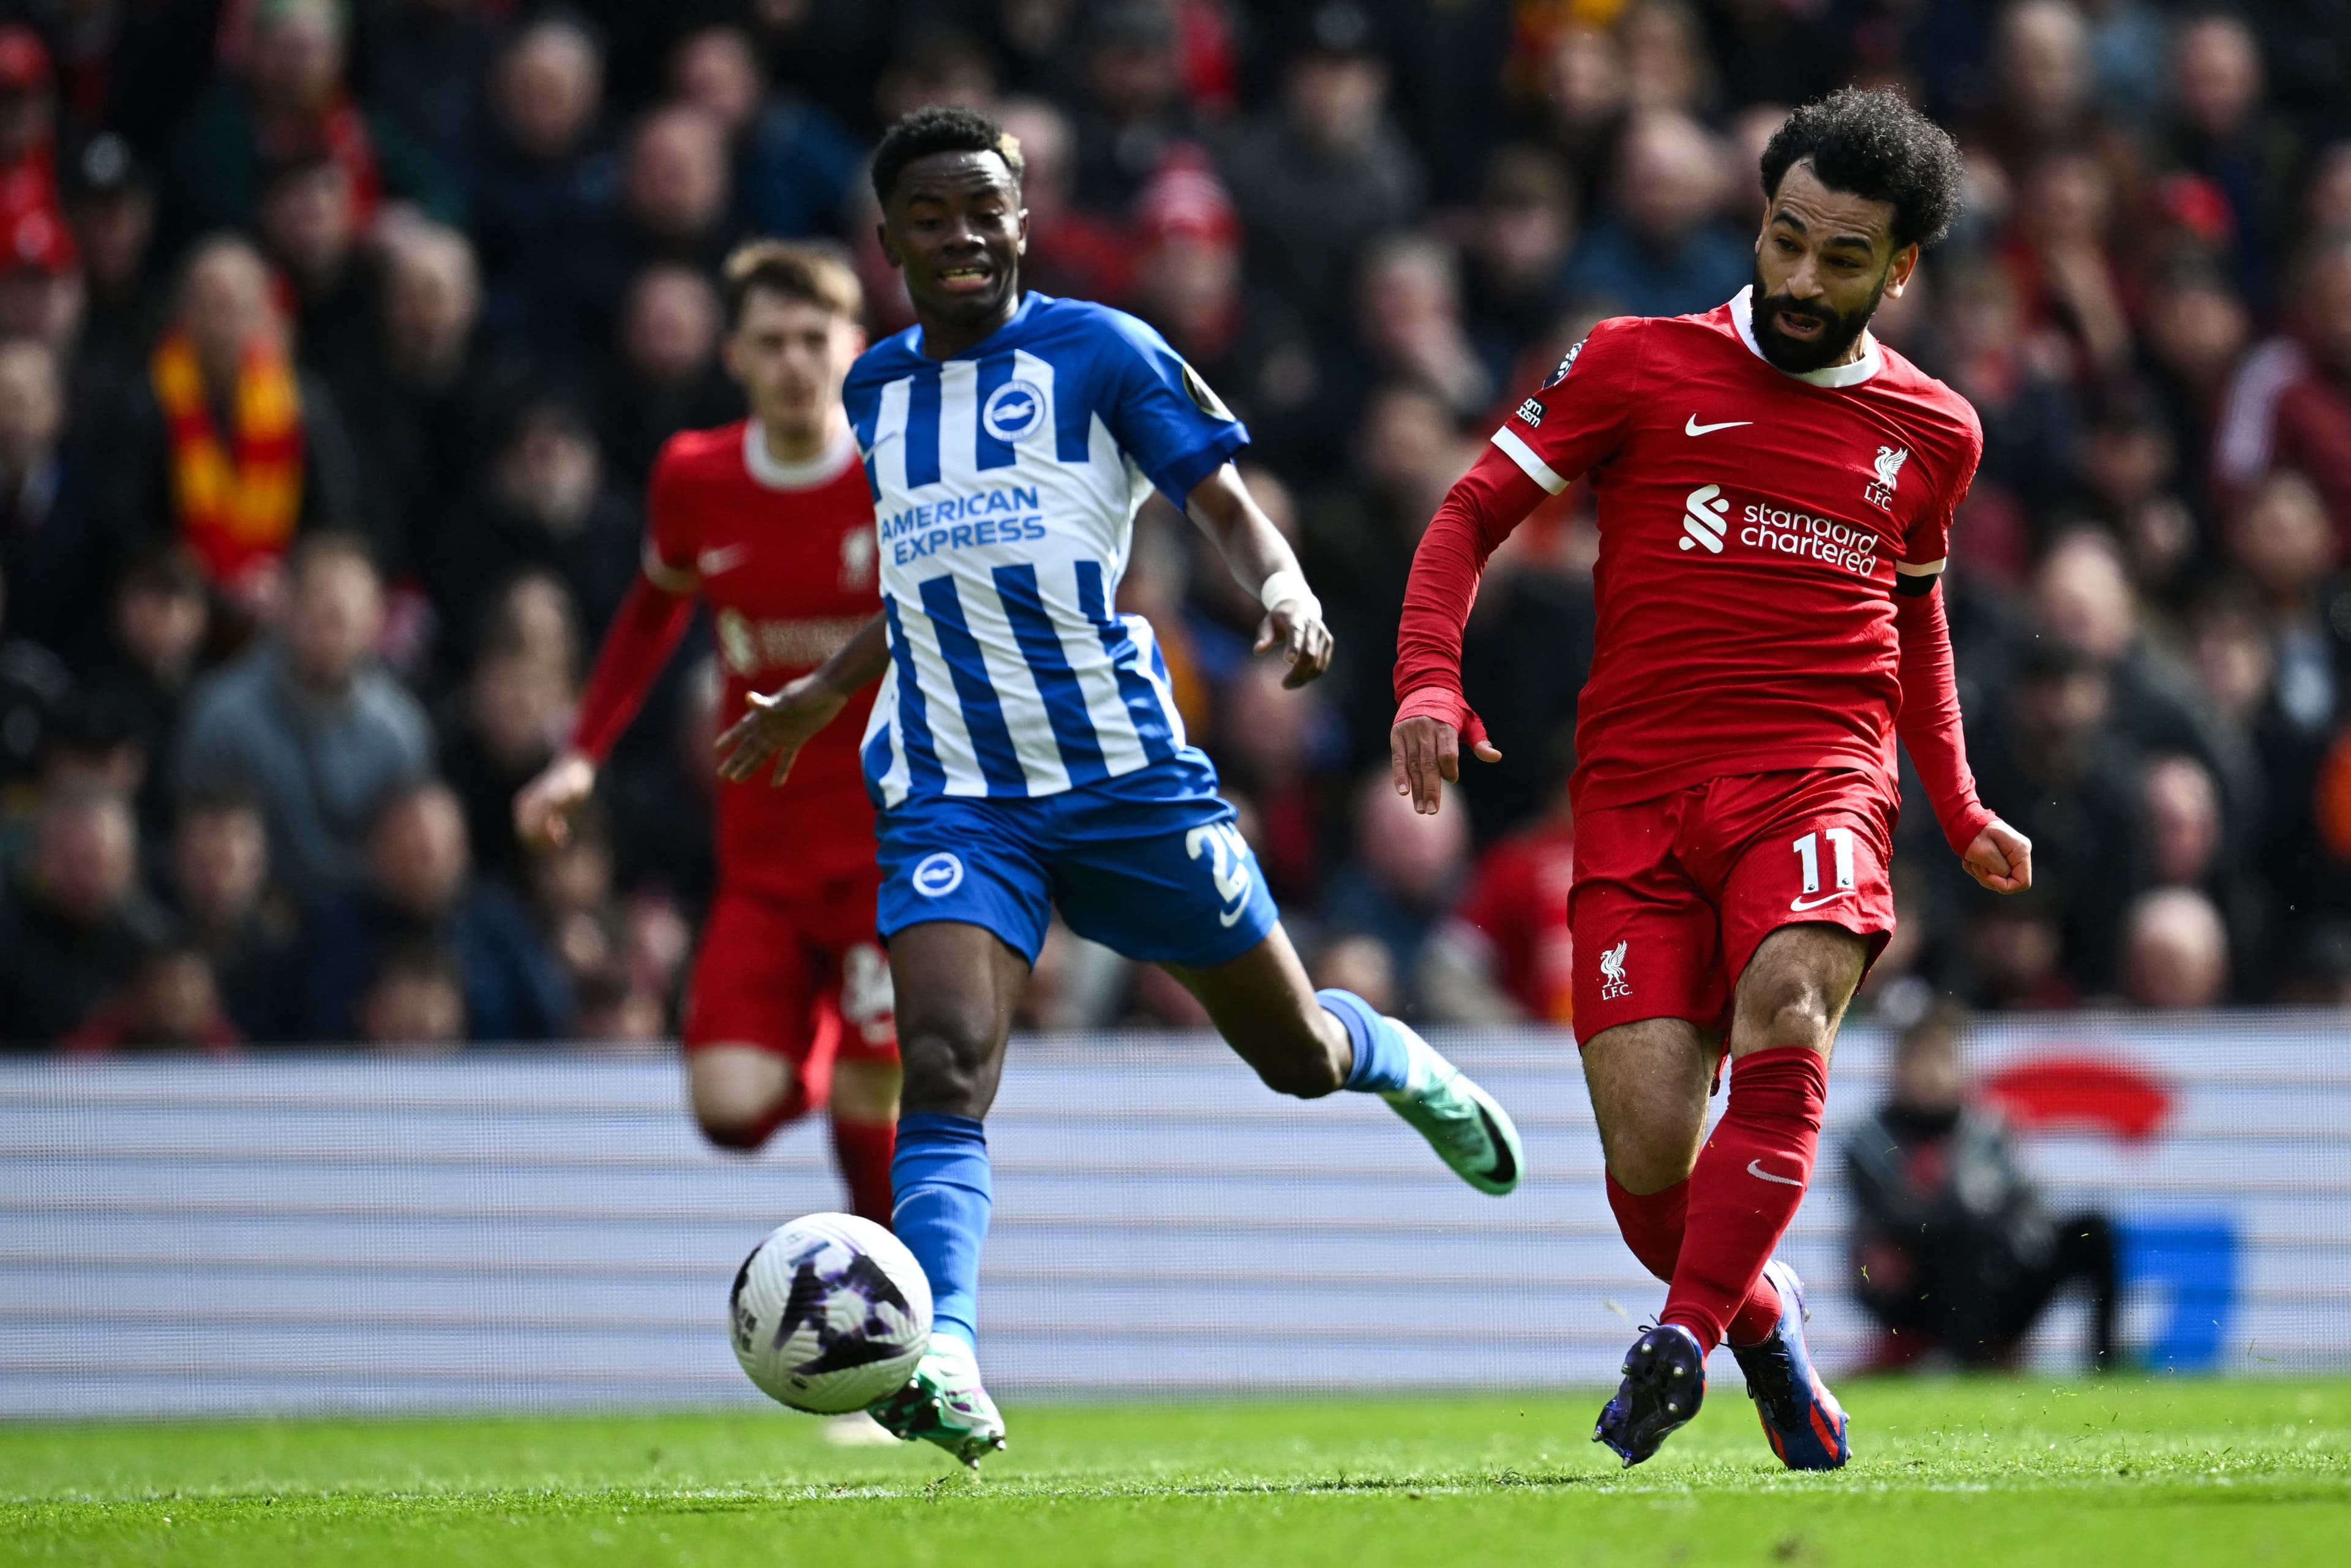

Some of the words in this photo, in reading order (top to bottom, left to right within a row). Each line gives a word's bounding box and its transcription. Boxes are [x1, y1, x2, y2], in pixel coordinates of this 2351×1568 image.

[882, 486, 1038, 542] AMERICAN
[1744, 503, 1878, 555] standard
[894, 516, 1046, 566] EXPRESS
[1741, 525, 1877, 577] chartered
[1793, 827, 1854, 894] 11
